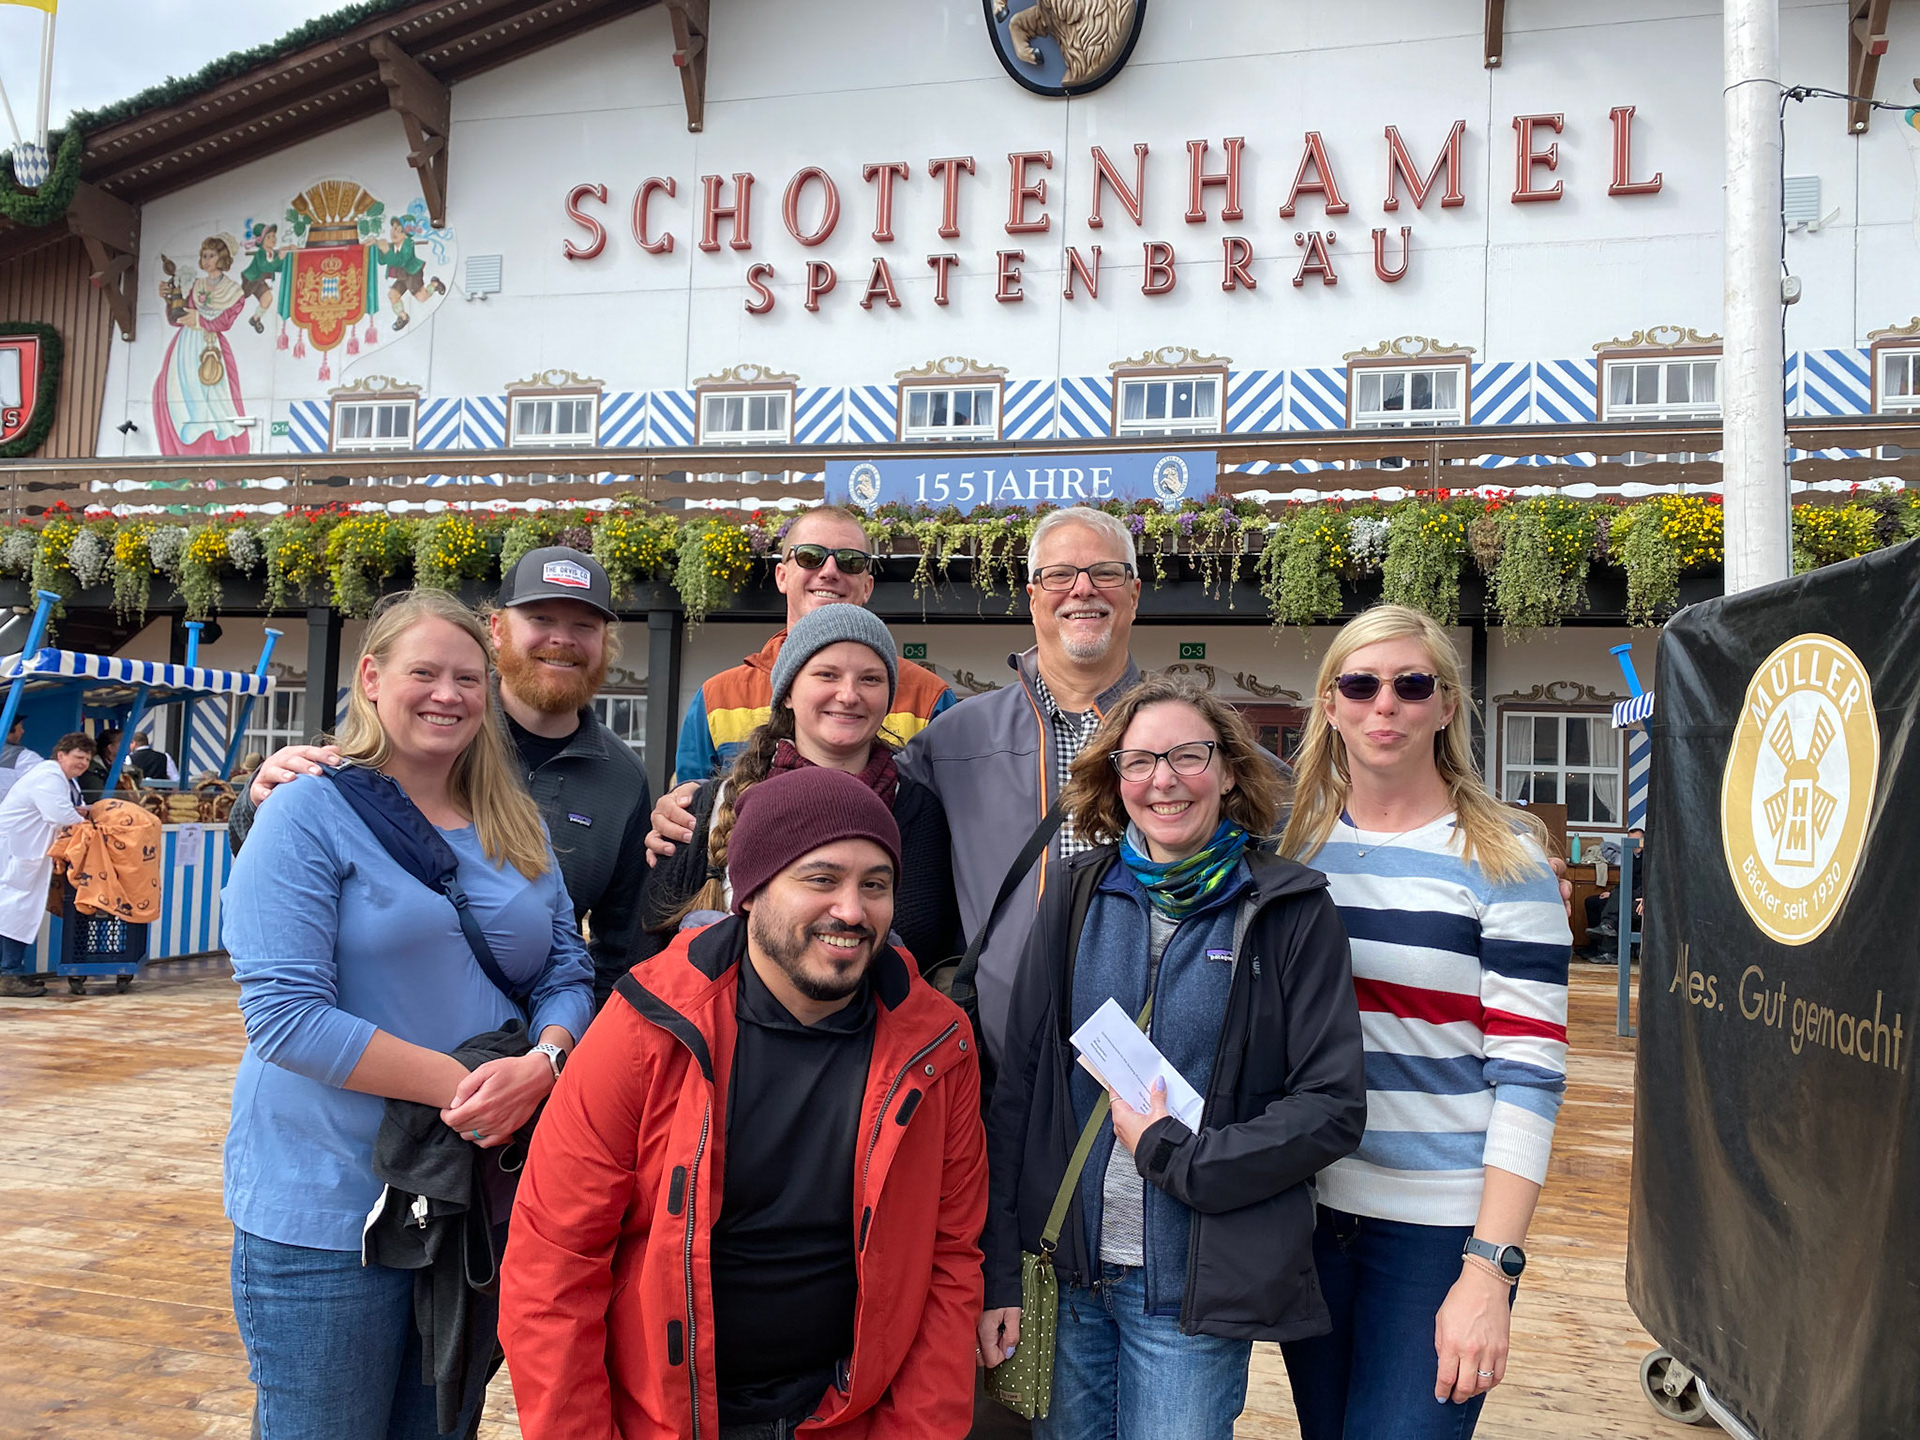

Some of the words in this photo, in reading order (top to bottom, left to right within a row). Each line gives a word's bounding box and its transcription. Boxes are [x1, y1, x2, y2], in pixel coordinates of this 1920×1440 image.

[564, 105, 1662, 260] SCHOTTENHAMEL
[745, 226, 1411, 314] SPATENBRÄU
[915, 471, 975, 502] 155
[981, 467, 1114, 505] JAHRE
[1751, 650, 1861, 731] MÜLLER
[1742, 853, 1780, 914] Bäcker
[1783, 898, 1808, 920] seit
[1812, 861, 1841, 911] 1930
[1738, 965, 1787, 1029] Gut
